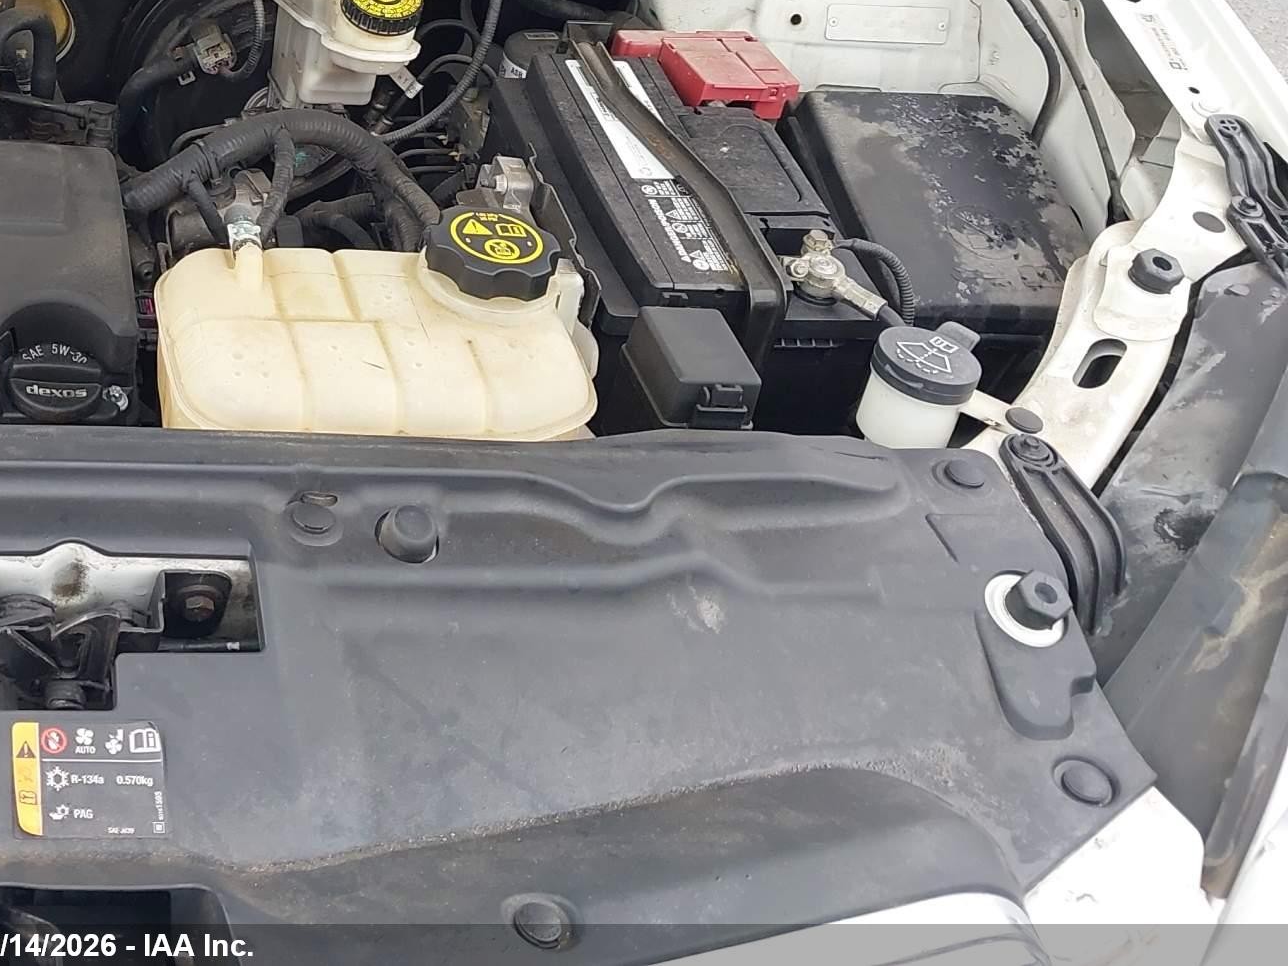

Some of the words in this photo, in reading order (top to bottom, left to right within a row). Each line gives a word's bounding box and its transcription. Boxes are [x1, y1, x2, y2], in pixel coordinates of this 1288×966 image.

[22, 345, 44, 361] SAE
[52, 344, 88, 364] 5W-30
[26, 385, 87, 398] dexos
[75, 745, 97, 754] AUTO
[70, 774, 104, 785] R-134a
[116, 775, 154, 787] 0.570kg
[73, 809, 94, 819] PAG
